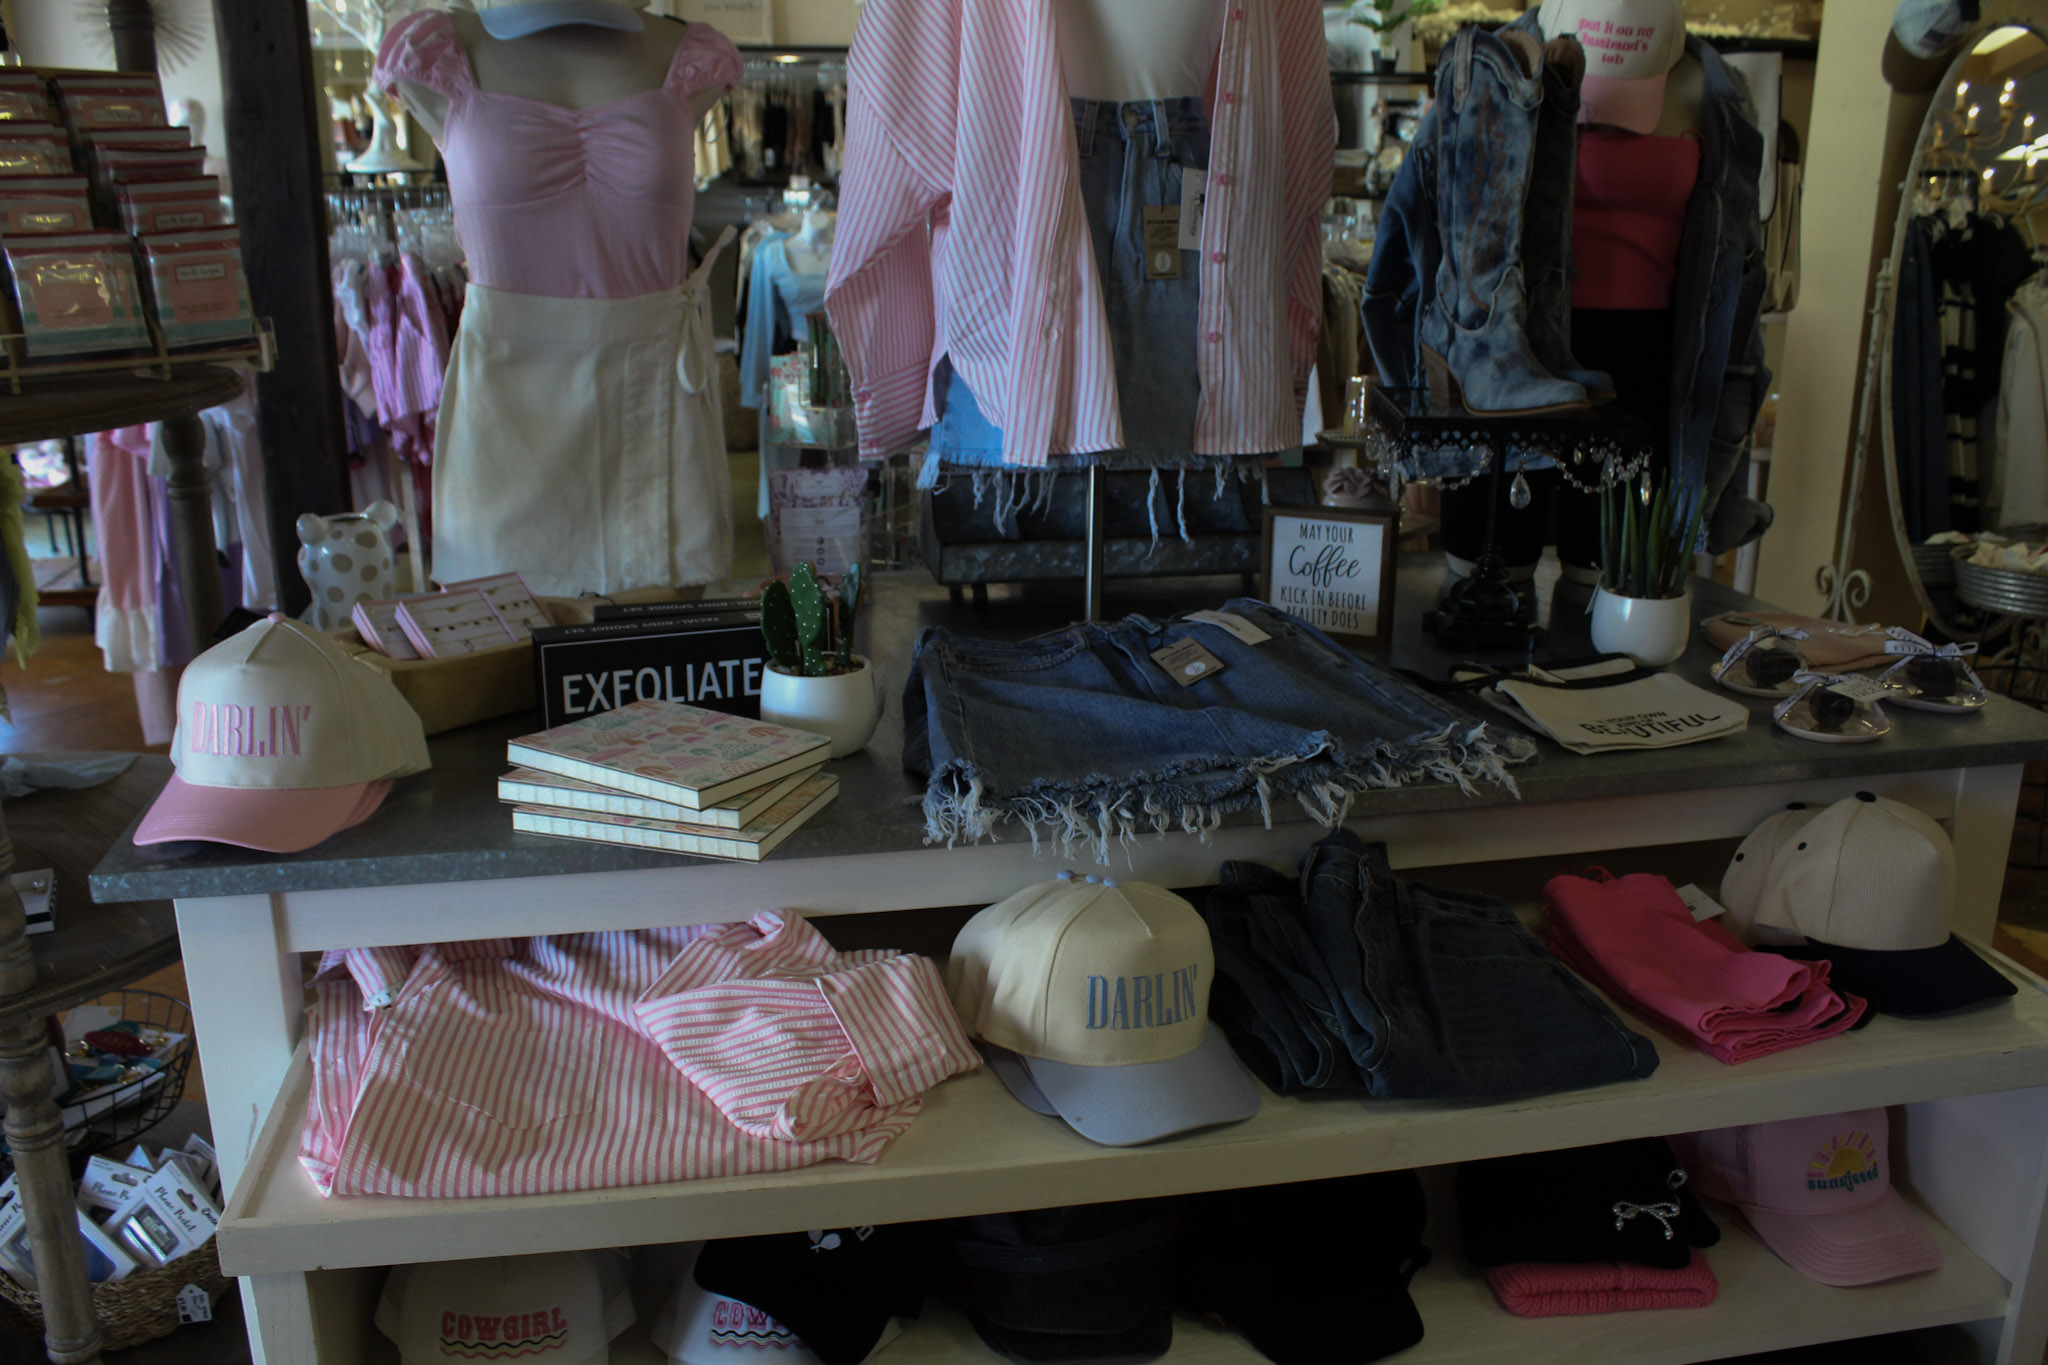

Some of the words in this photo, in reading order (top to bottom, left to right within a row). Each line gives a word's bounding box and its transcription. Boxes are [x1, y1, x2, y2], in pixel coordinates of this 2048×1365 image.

[1578, 18, 1600, 32] put
[1604, 20, 1614, 34] it
[1616, 26, 1634, 37] on
[1636, 26, 1656, 39] my
[1582, 32, 1648, 51] husband's
[1601, 53, 1624, 65] tab
[1300, 523, 1322, 540] MAY
[1325, 525, 1353, 543] YOUR
[1289, 544, 1362, 588] Coffee
[1280, 586, 1307, 605] KICK
[1311, 589, 1325, 606] IN
[1328, 591, 1367, 611] BEFORE
[564, 627, 585, 635] SET
[642, 620, 675, 628] BODY
[1331, 610, 1359, 630] DOES
[561, 657, 763, 715] EXFOLIATE
[191, 700, 312, 757] DARLIN'
[1085, 962, 1198, 1030] DARLIN'
[155, 1186, 175, 1210] Phone
[440, 1306, 568, 1341] COWGIRL
